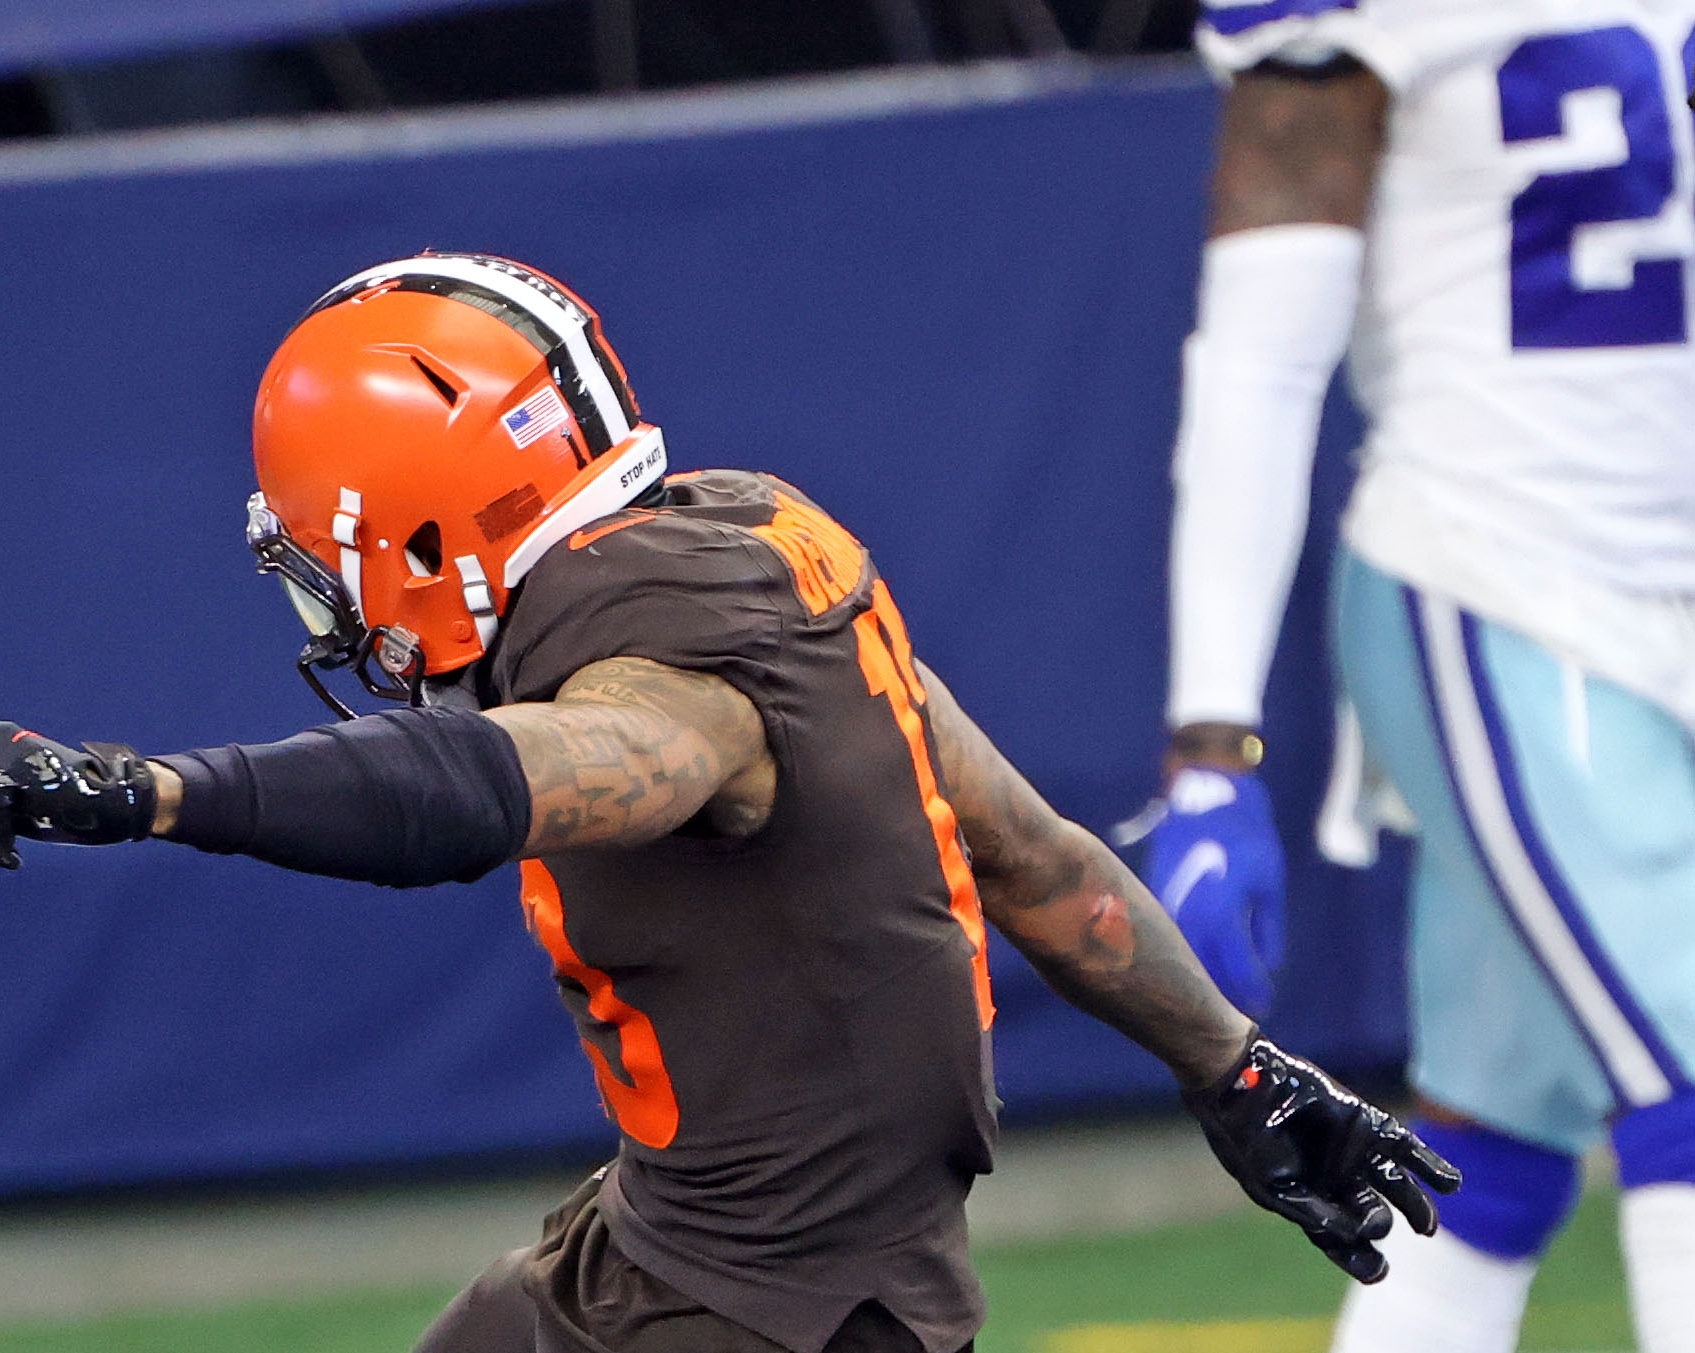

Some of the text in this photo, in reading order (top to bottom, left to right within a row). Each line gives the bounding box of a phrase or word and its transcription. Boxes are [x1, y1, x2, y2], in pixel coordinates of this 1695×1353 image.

[1497, 26, 1695, 347] 2
[620, 446, 662, 488] STOP HATE
